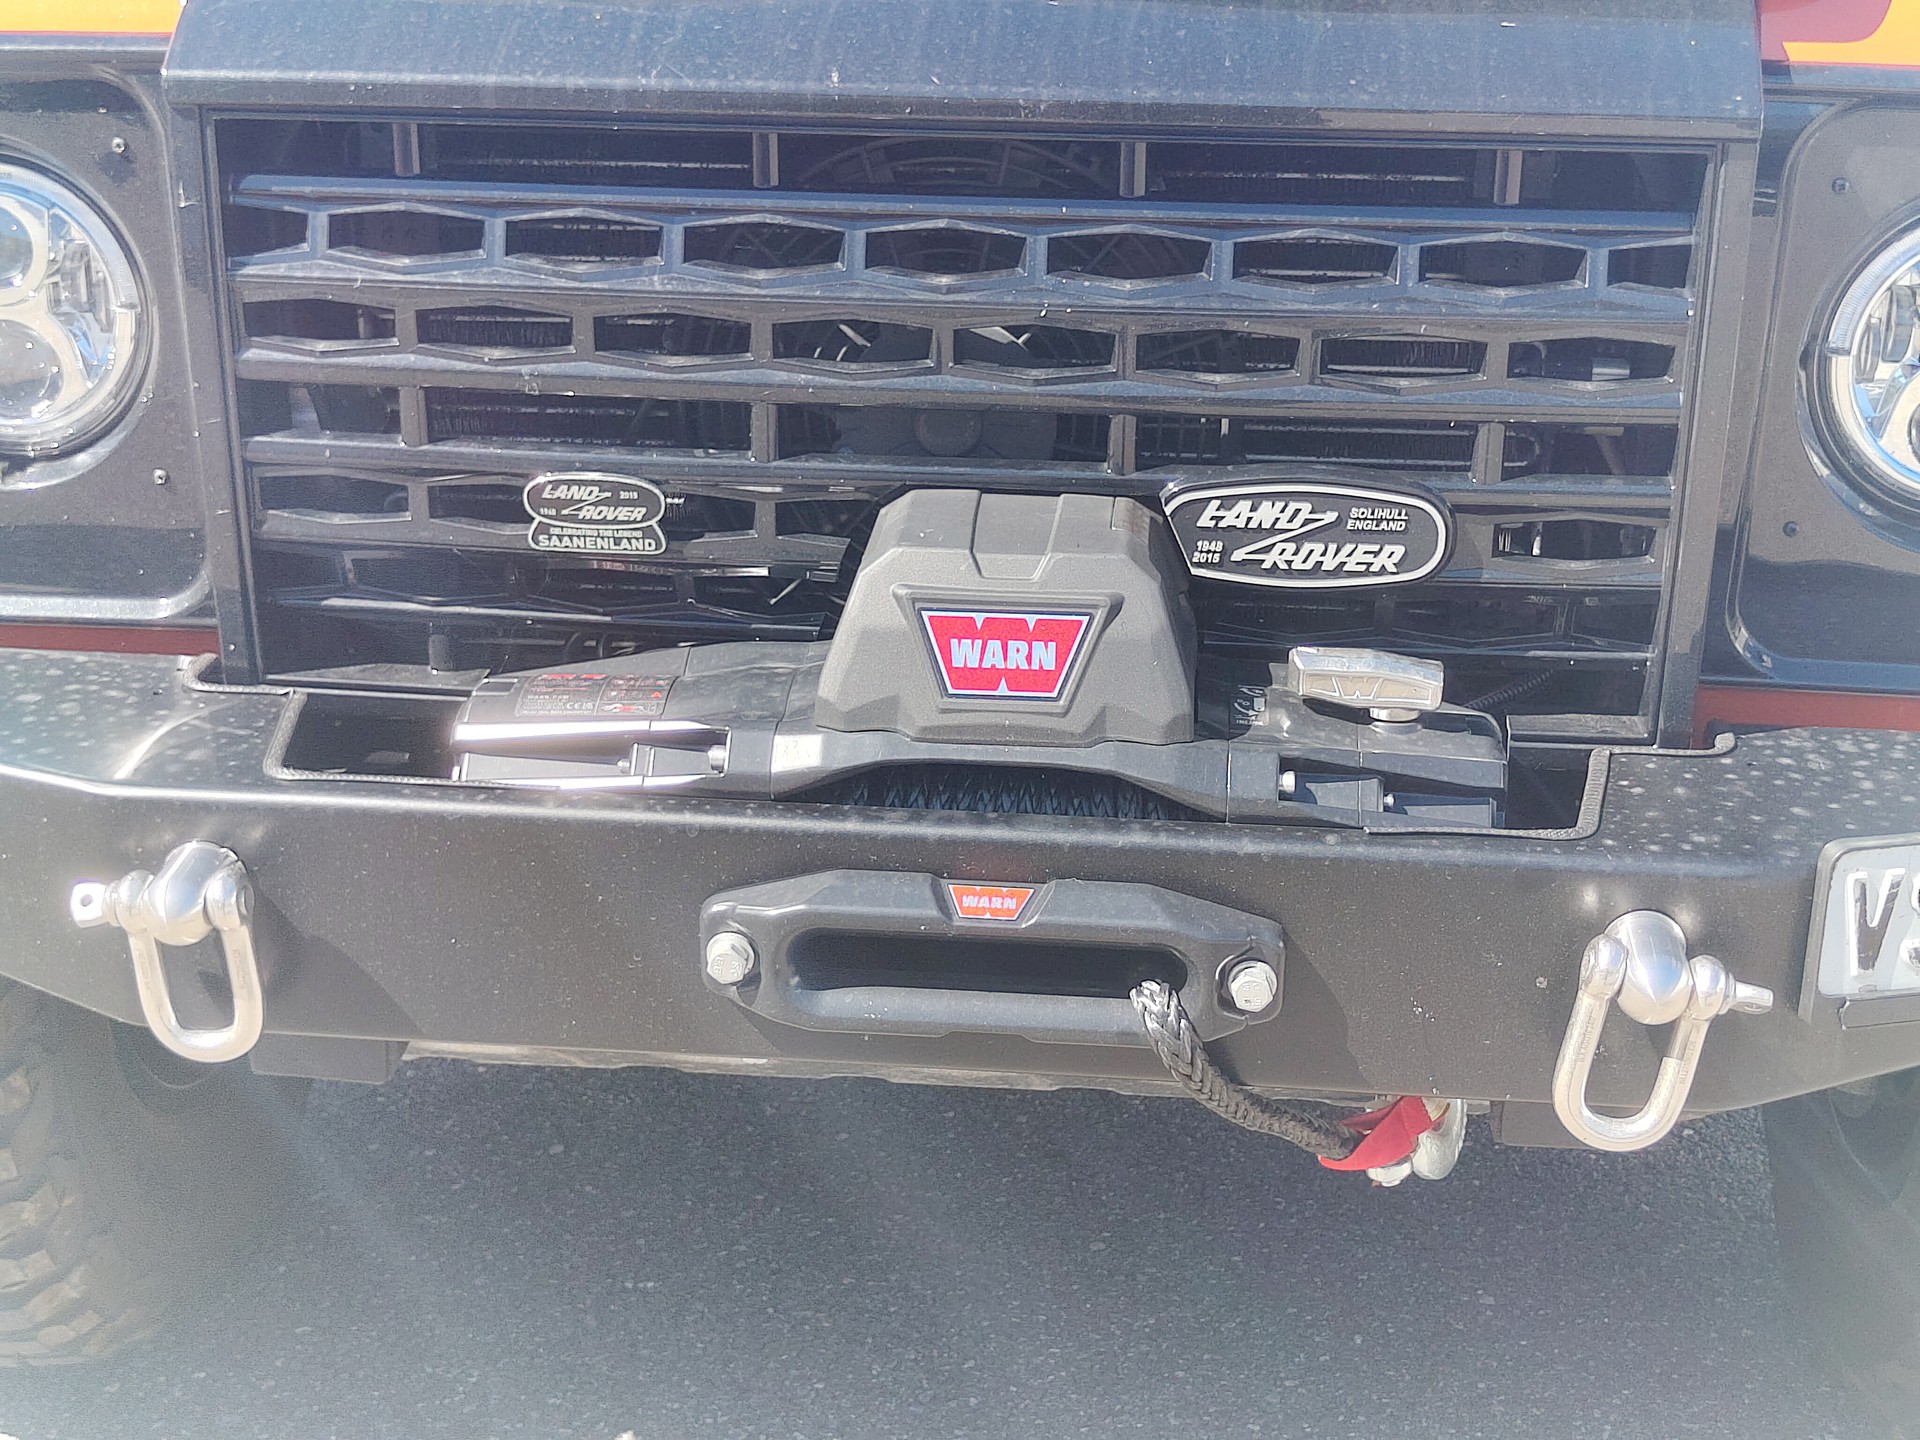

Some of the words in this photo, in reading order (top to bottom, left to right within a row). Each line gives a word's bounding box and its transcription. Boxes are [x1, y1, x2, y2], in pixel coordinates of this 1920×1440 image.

[542, 485, 600, 500] LAND
[578, 505, 647, 522] ROVER
[1196, 499, 1314, 530] LAND
[1349, 507, 1409, 521] SOLIHULL
[1346, 519, 1406, 532] ENGLAND
[538, 534, 656, 551] SAANENLAND
[1196, 540, 1223, 552] 1948
[1260, 541, 1406, 573] ROVER
[950, 638, 1056, 671] WARN
[962, 895, 1016, 910] WARN
